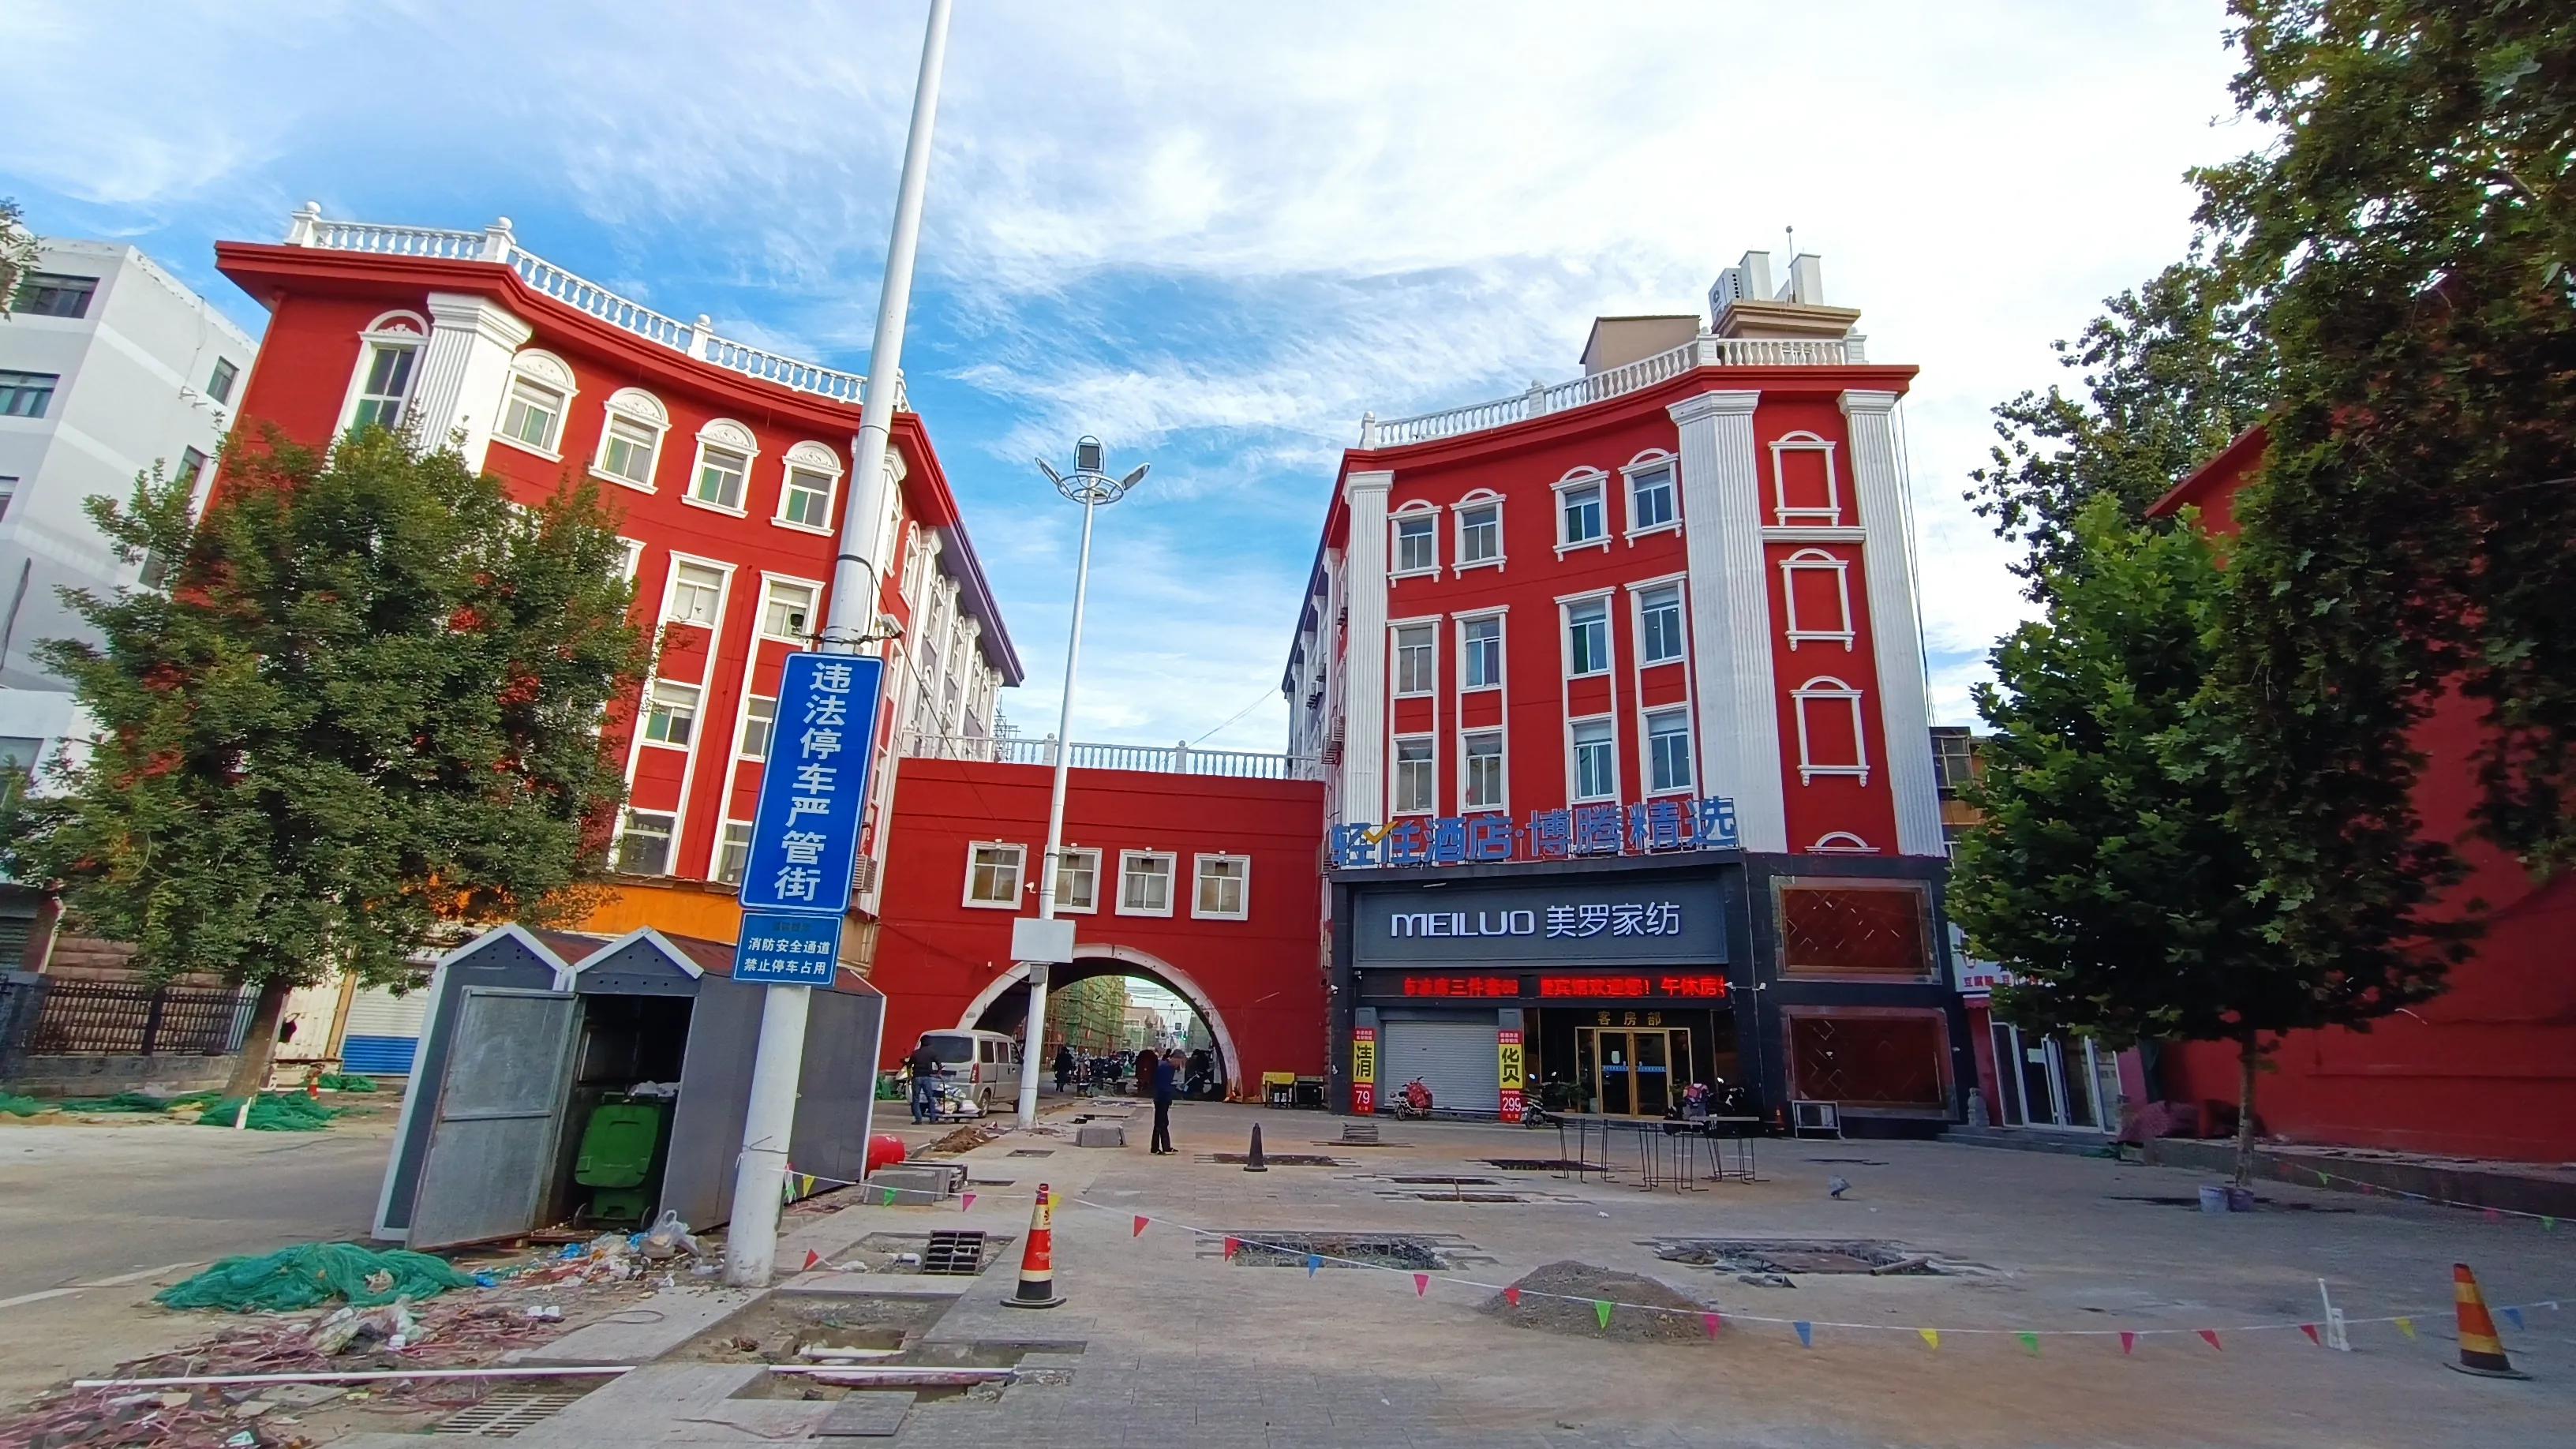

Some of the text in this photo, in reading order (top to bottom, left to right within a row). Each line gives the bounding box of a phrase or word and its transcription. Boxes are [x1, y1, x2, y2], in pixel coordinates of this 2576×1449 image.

[774, 662, 852, 901] 违法停车严管街
[1391, 902, 1680, 938] MEILUO 美罗家纺
[748, 938, 830, 954] 消防安全通道
[744, 958, 826, 975] 禁止停车占用
[1597, 1010, 1661, 1026] 客房部
[1356, 1045, 1372, 1077] 清
[1501, 1047, 1520, 1083] 货
[1356, 1090, 1371, 1104] 79
[1502, 1097, 1522, 1112] 299
